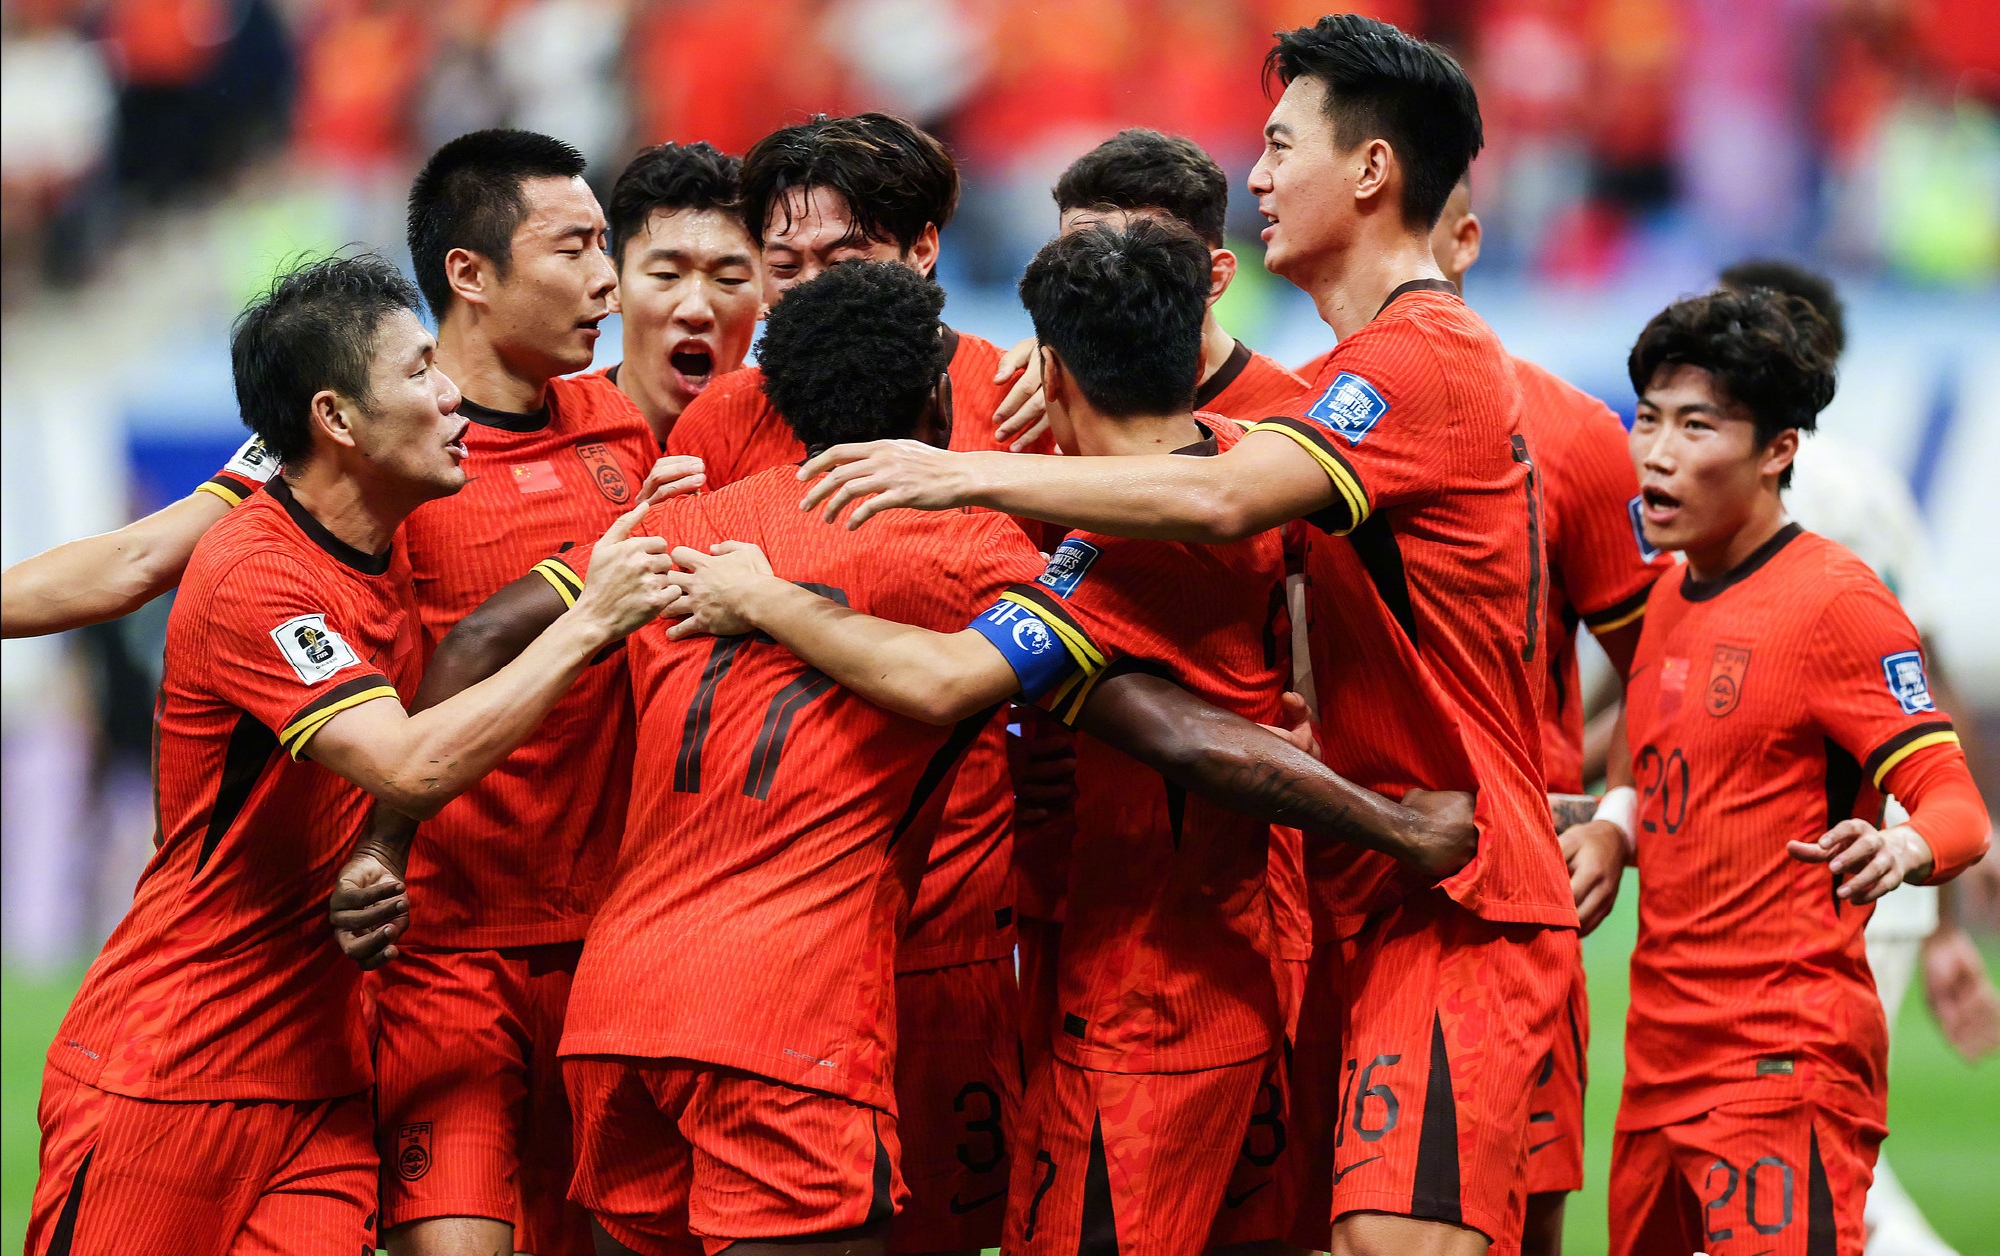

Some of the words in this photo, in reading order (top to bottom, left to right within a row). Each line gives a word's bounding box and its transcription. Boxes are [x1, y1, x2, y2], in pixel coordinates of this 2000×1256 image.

[1334, 389, 1369, 419] UNITES
[673, 580, 851, 801] 17
[1641, 743, 1690, 835] 20
[953, 1081, 1005, 1175] 3
[1335, 1053, 1402, 1148] 16
[1705, 1155, 1794, 1243] 20
